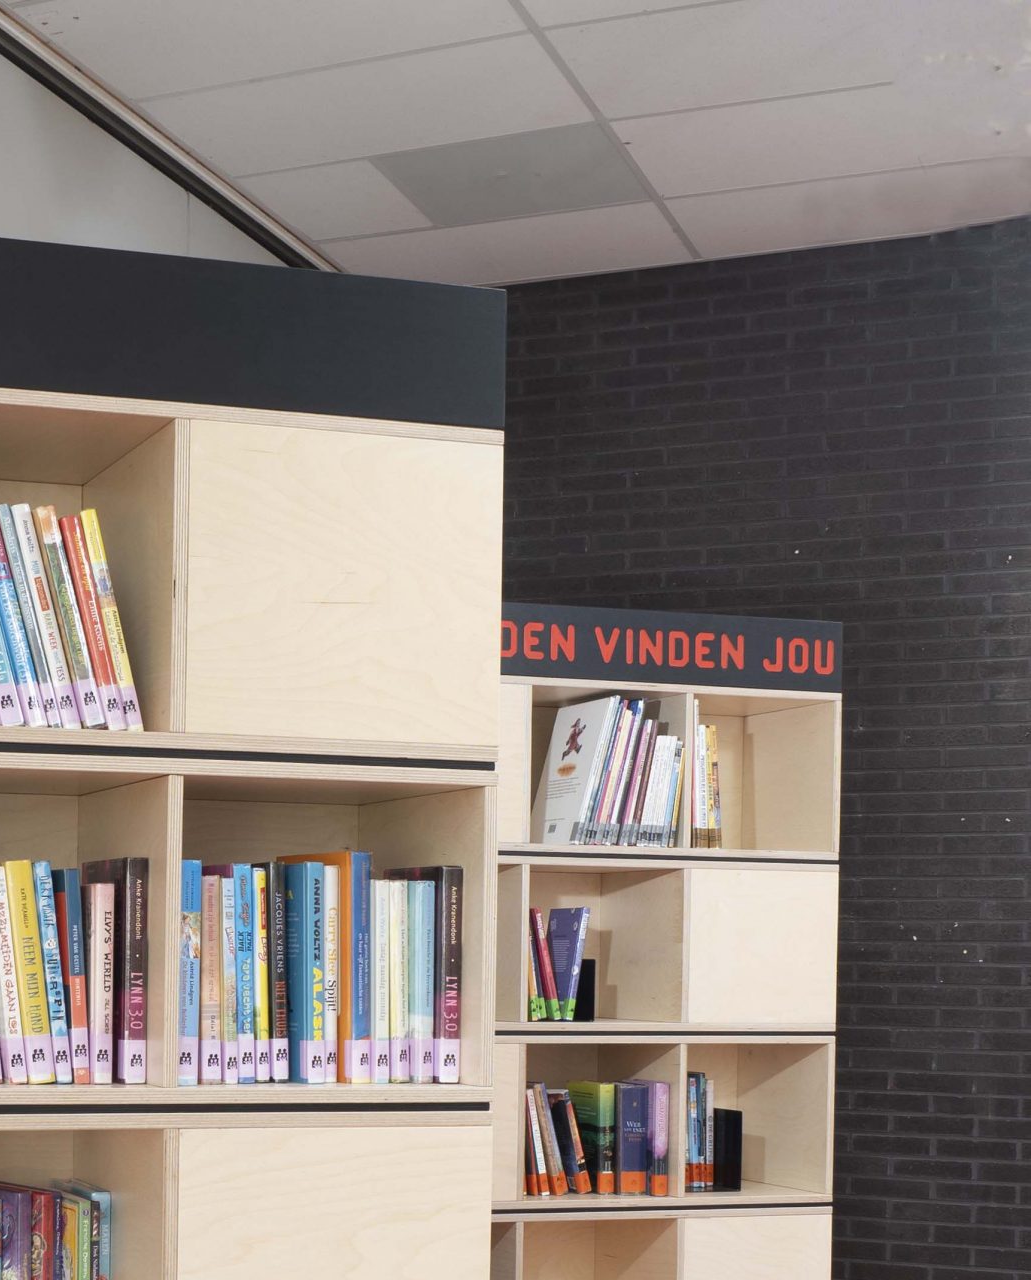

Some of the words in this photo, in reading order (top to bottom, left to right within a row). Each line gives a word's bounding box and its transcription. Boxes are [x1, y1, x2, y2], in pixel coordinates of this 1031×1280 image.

[501, 620, 575, 662] DEN
[595, 627, 745, 670] VINDEN
[763, 637, 835, 675] JOU
[104, 911, 112, 943] ELVY'S
[135, 899, 143, 940] Kranendonk
[274, 891, 282, 935] JACQUES
[326, 907, 337, 945] Carry
[450, 905, 458, 944] Kranendonk
[275, 939, 283, 973] VRIENS
[313, 919, 321, 961] WOLTZ
[104, 953, 112, 992] WERELD
[328, 948, 337, 975] Slee
[22, 937, 37, 966] NEEM
[30, 1005, 44, 1033] HAND
[130, 972, 143, 1004] LYNN
[275, 981, 285, 1002] NIET
[325, 979, 337, 1012] Spijt!
[446, 976, 457, 1006] LYNN
[129, 1009, 143, 1030] 3.0
[275, 1007, 286, 1037] THUIS
[444, 1012, 458, 1032] 3.0
